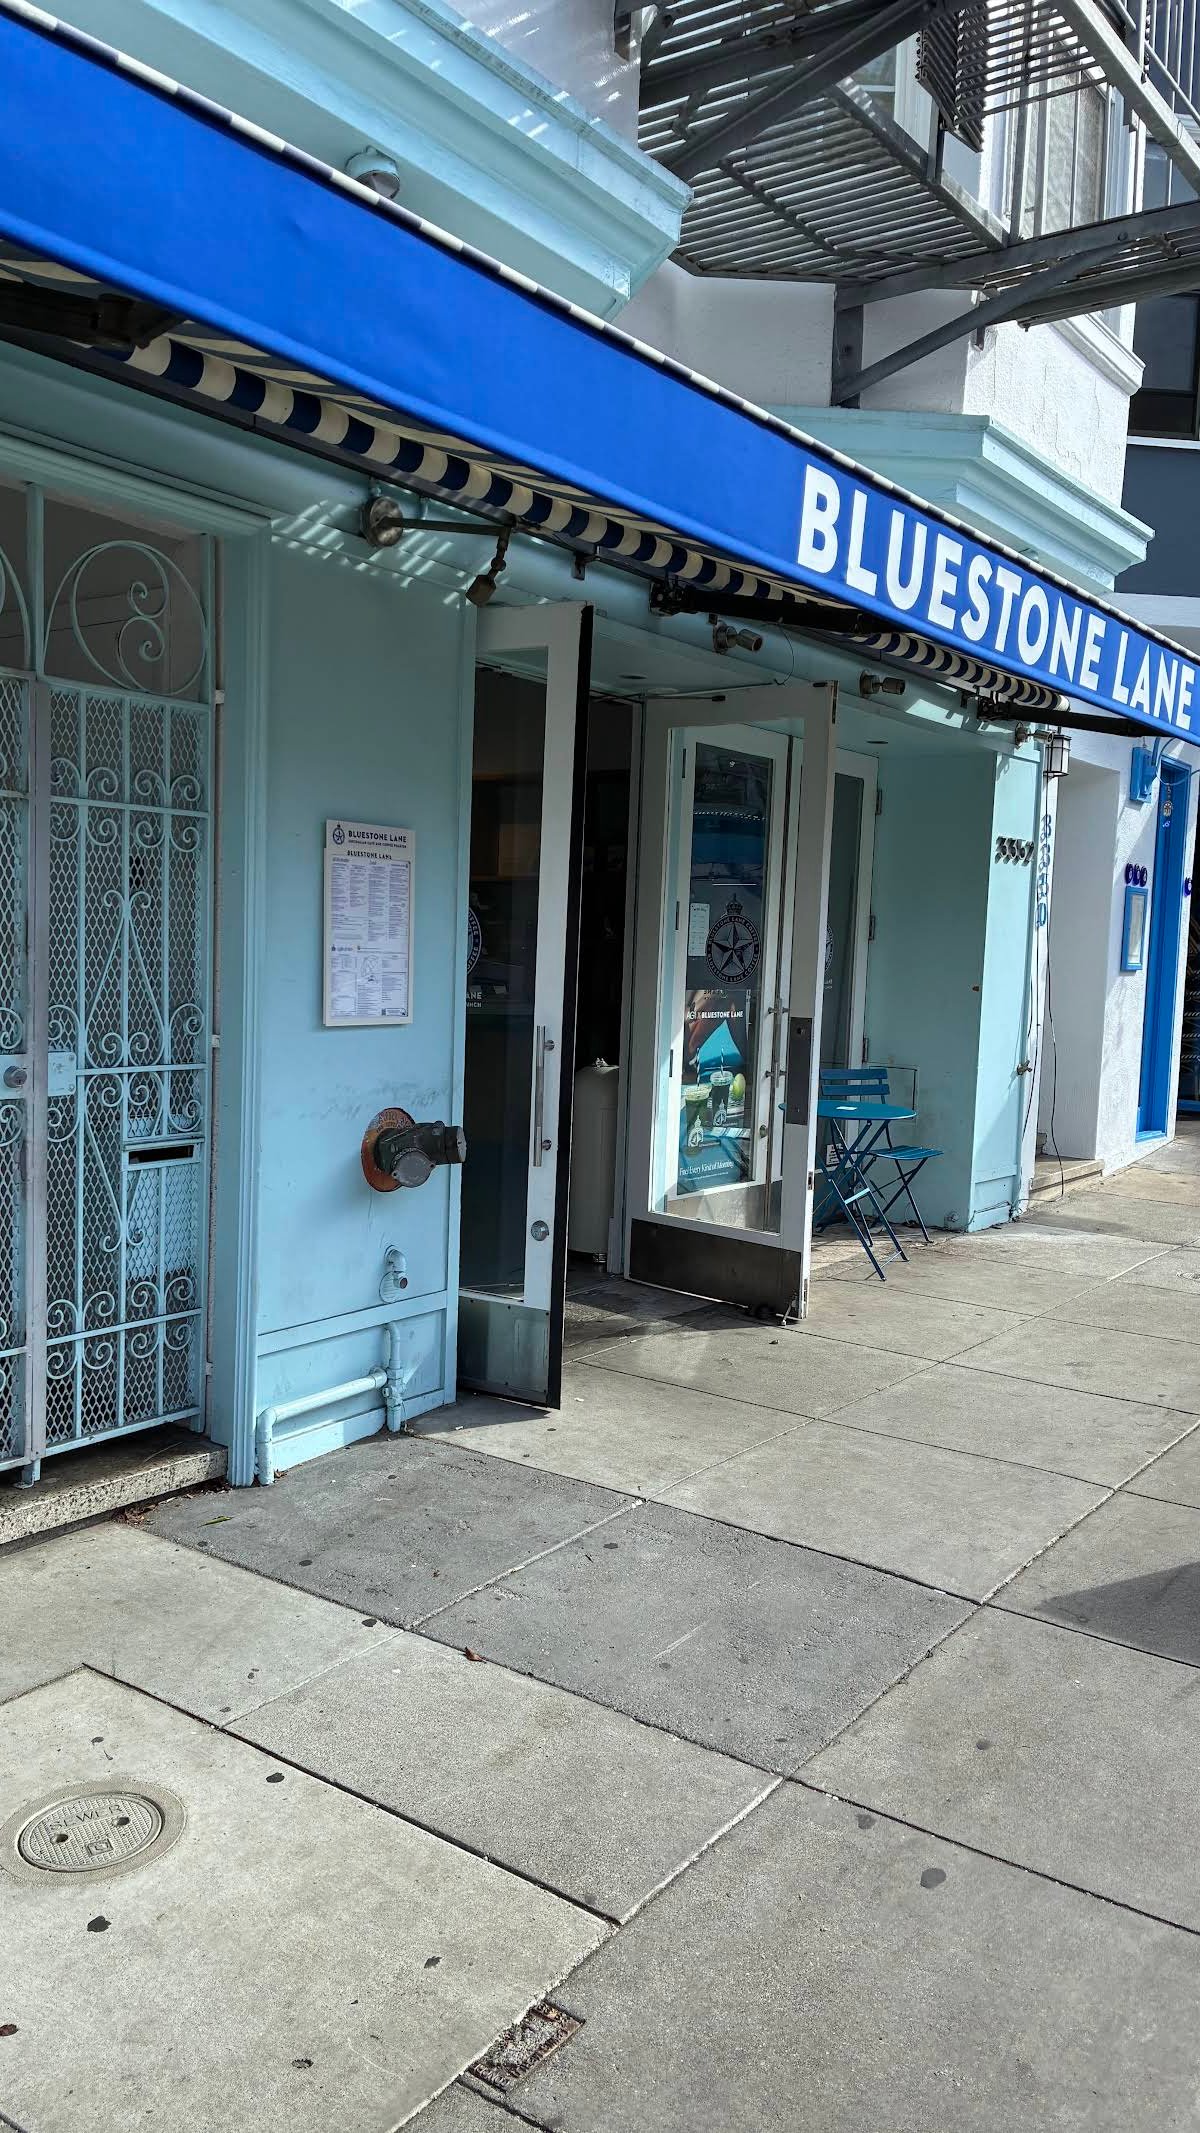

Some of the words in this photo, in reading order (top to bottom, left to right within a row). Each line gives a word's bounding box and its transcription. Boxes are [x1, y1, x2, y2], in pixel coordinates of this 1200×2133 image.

[796, 463, 1107, 691] BLUESTONE
[1111, 631, 1199, 731] LANE
[348, 830, 388, 840] BLUESTONE
[389, 834, 407, 843] LANE
[347, 850, 379, 859] BLUESTONE
[379, 853, 393, 861] LANE
[701, 1011, 730, 1019] BLUESTONE
[730, 1010, 744, 1018] LANE
[51, 1804, 123, 1830] SEWER
